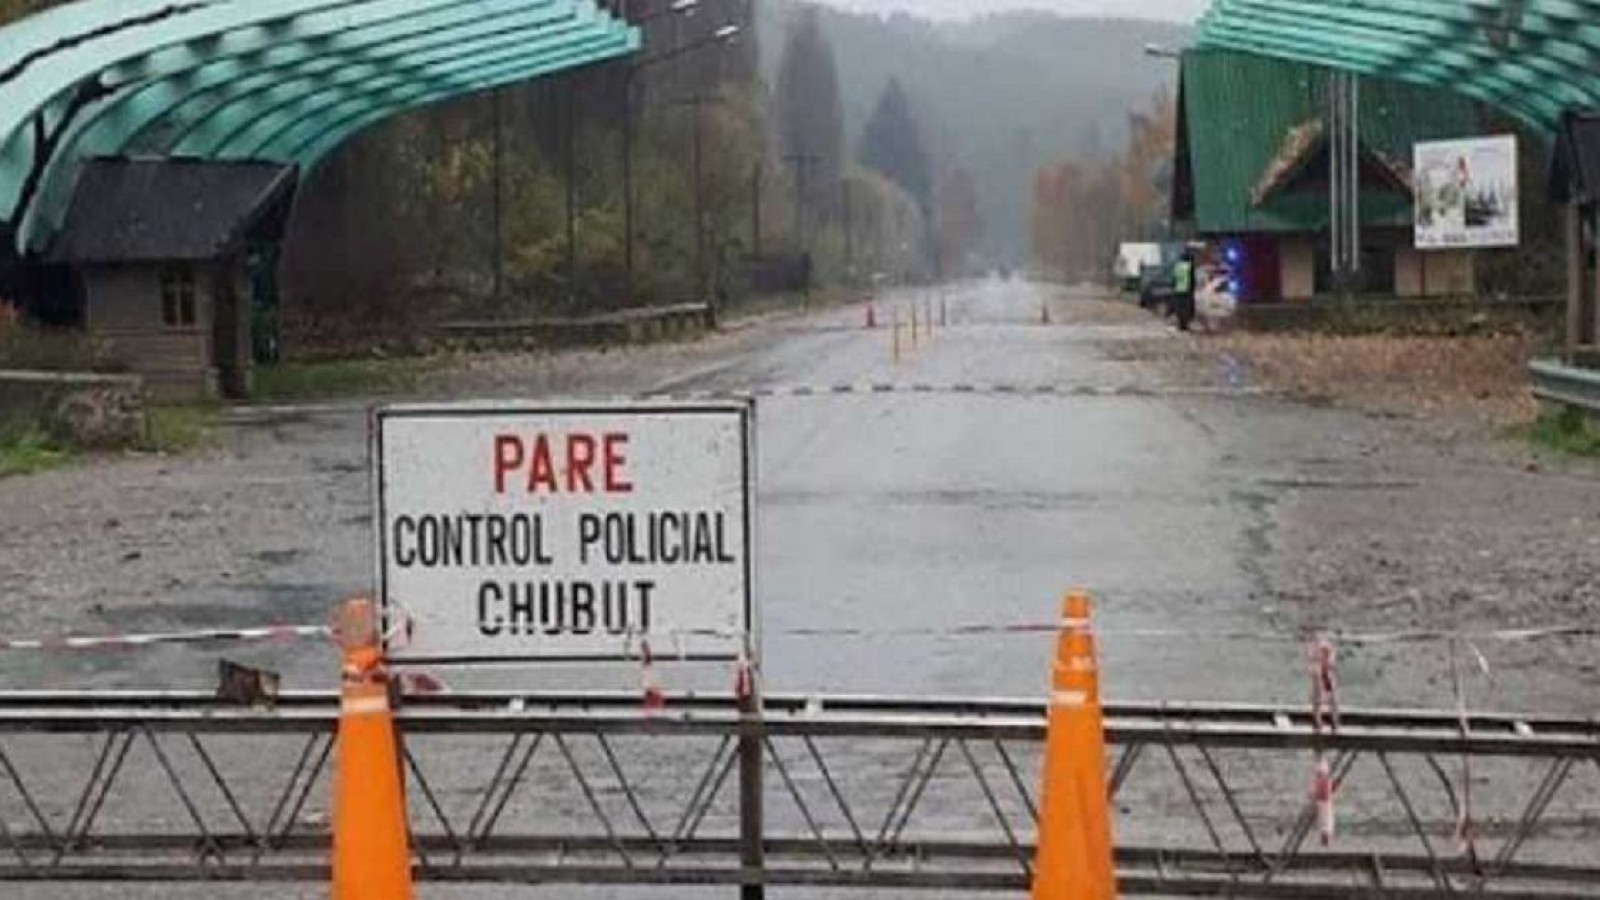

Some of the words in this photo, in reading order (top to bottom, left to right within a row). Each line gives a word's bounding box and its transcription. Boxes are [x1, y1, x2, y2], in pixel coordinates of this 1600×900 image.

[494, 432, 634, 494] PARE
[393, 511, 552, 568] CONTROL
[579, 511, 735, 565] POLICIAL
[478, 578, 656, 637] CHUBUT
